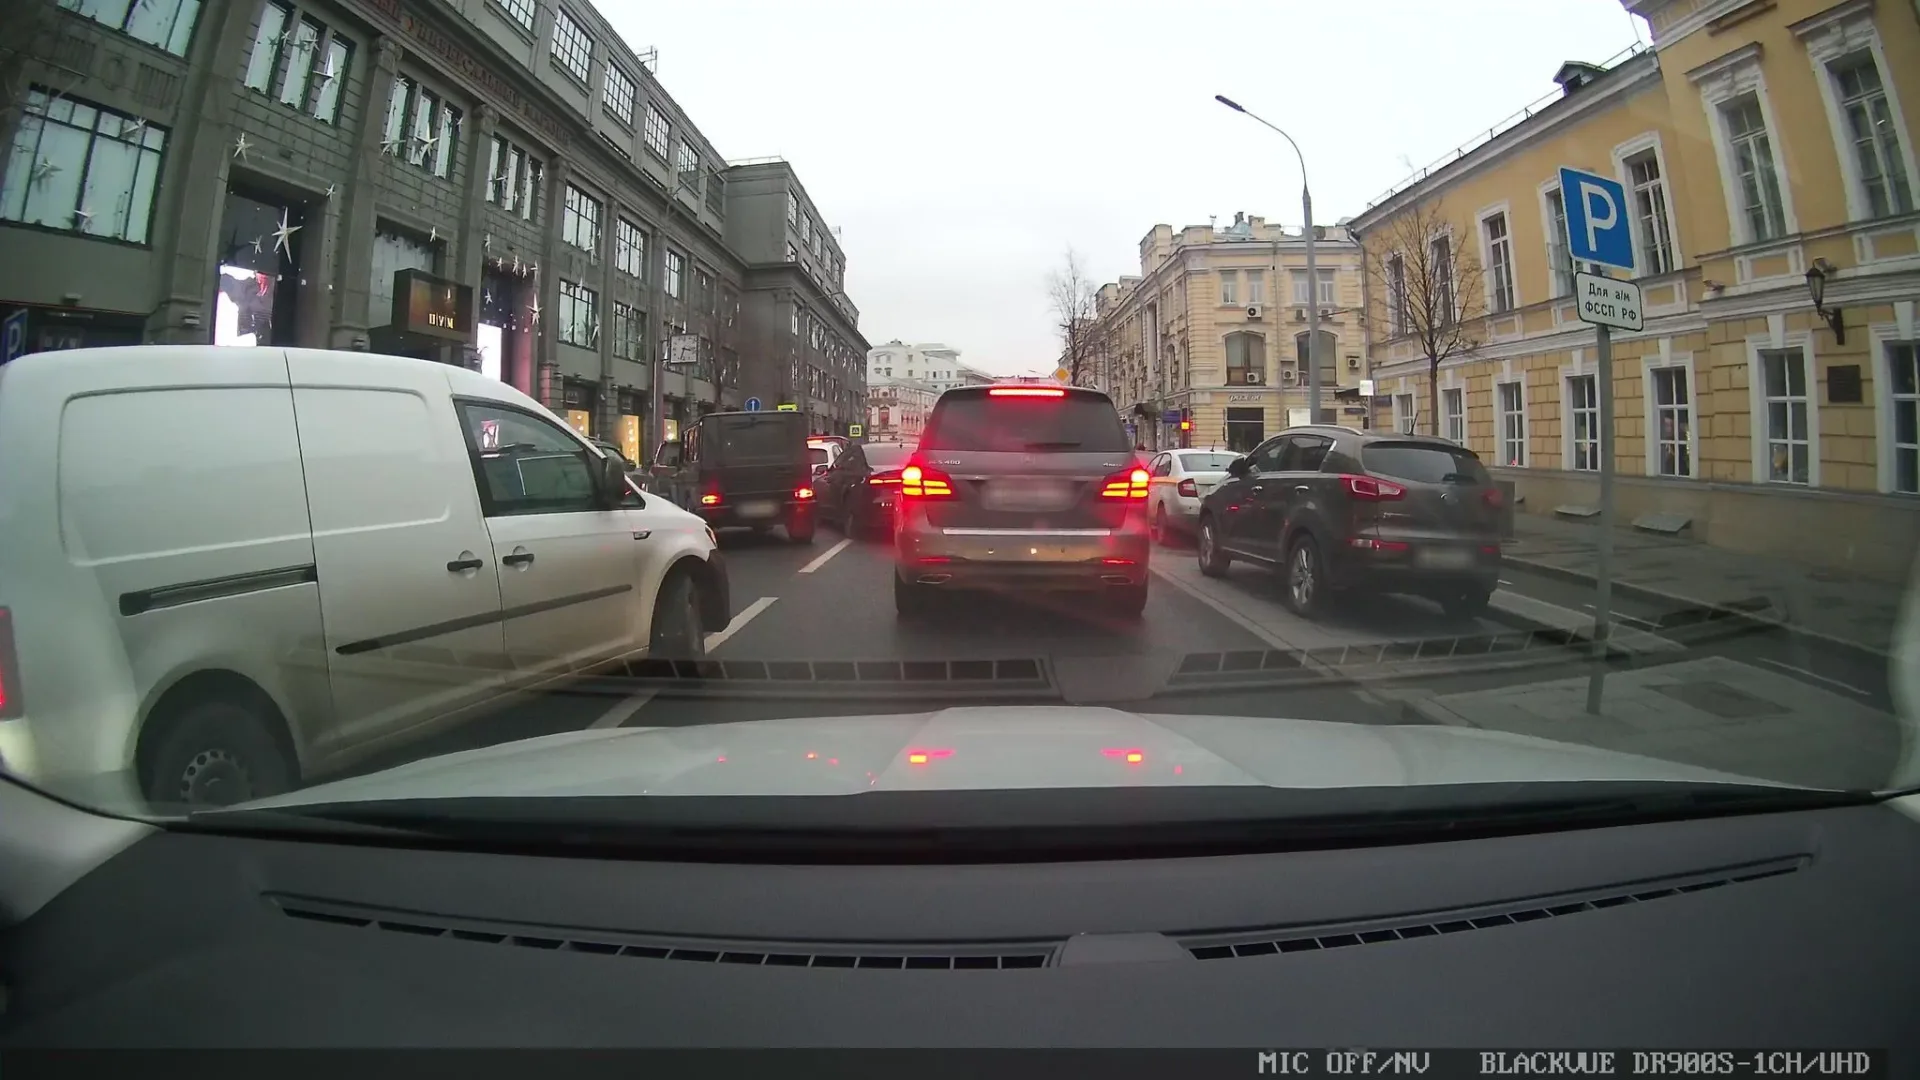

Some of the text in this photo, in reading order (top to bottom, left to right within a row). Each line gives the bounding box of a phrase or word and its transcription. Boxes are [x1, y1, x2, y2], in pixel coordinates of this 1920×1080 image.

[1580, 181, 1618, 252] P
[1589, 283, 1631, 302] Для а/м
[1585, 301, 1637, 321] ФССП РФ
